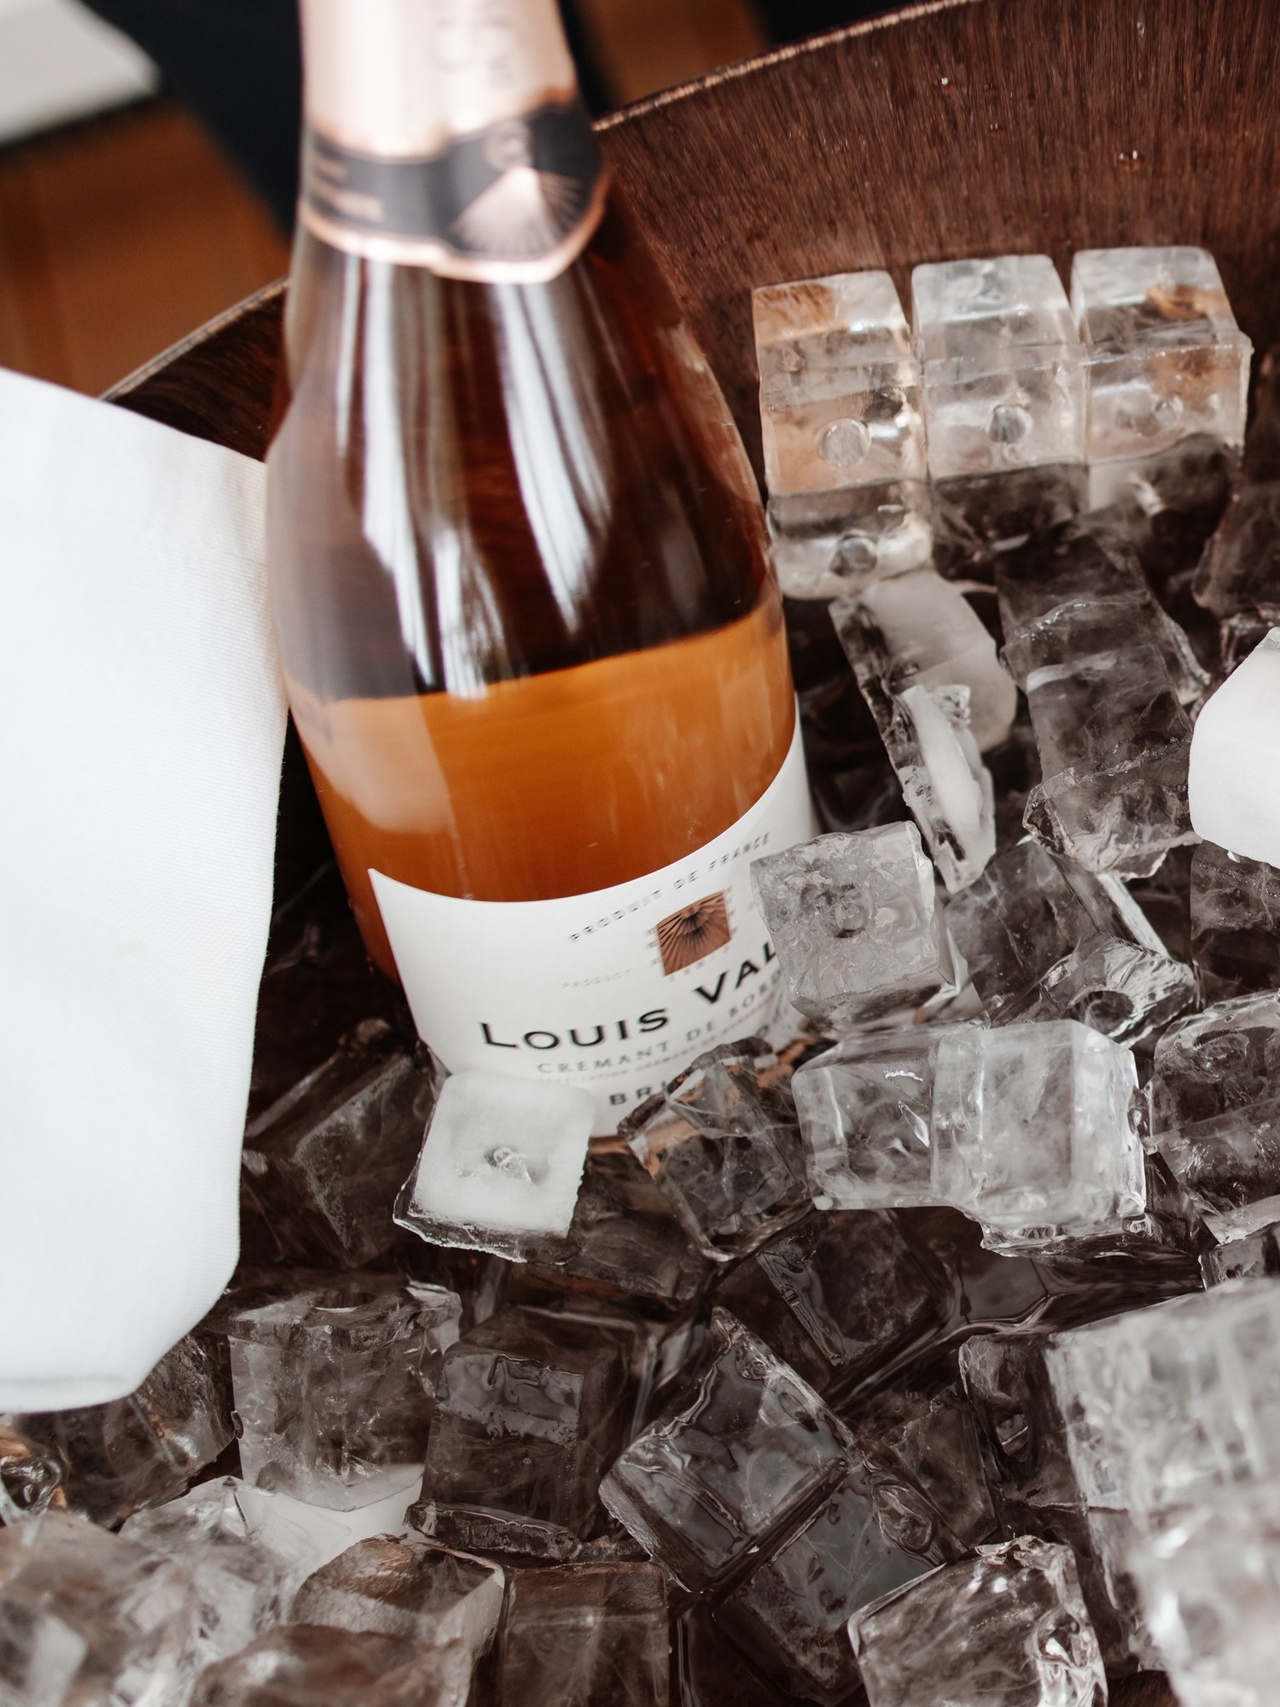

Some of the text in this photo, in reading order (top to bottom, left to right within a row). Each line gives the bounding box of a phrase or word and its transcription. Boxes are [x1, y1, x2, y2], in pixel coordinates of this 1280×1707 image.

[569, 832, 770, 943] PRODUIT DE FRANCE
[479, 1008, 669, 1050] LOUIS
[537, 1040, 670, 1073] CREMANT
[687, 1021, 712, 1041] DE
